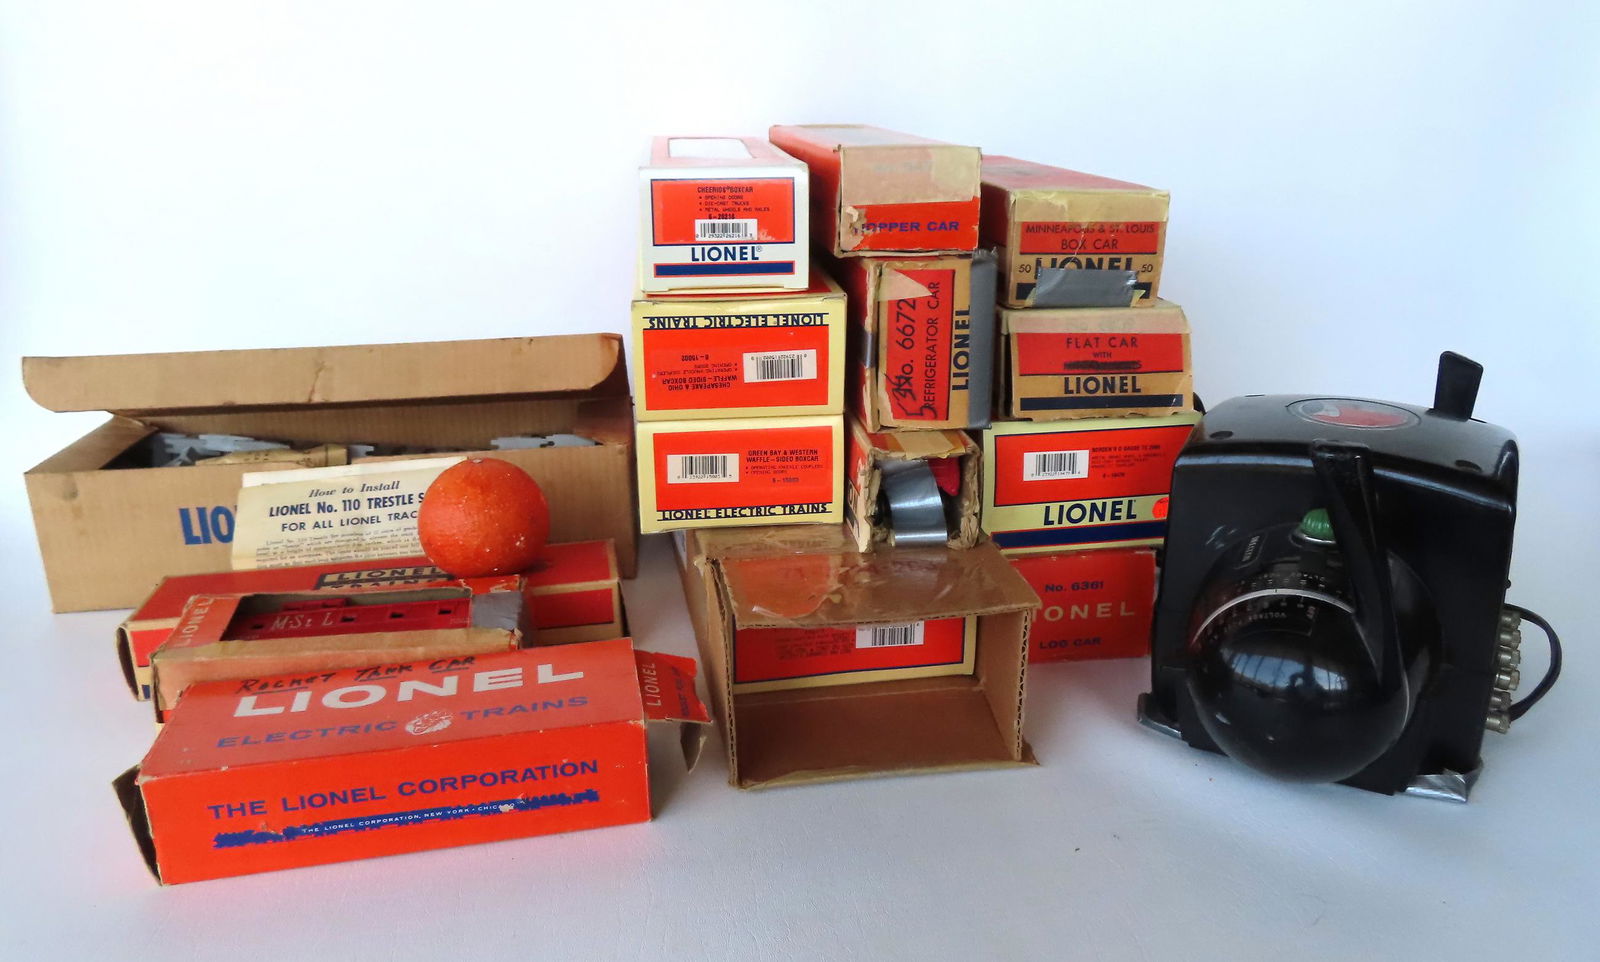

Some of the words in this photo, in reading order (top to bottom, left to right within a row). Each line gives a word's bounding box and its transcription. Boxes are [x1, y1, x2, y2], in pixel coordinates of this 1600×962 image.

[927, 221, 959, 231] CAR
[1125, 224, 1155, 233] LOUIS
[1061, 239, 1086, 250] BOX
[1093, 239, 1118, 250] CAR
[1018, 264, 1031, 273] 50
[1141, 264, 1153, 273] 50
[927, 282, 940, 310] CAR
[649, 317, 698, 329] TRAINS
[704, 315, 768, 327] ELECTRIC
[774, 314, 824, 326] LIONEL
[896, 299, 916, 350] 6672
[952, 305, 970, 391] LIONEL
[1066, 338, 1100, 348] FLAT
[1108, 336, 1139, 348] CAR
[924, 317, 939, 408] REFRIGERATOR
[692, 382, 730, 390] CHESAPEAKE
[1064, 376, 1141, 394] LIONEL
[309, 489, 336, 498] How
[360, 480, 400, 493] Install
[269, 503, 311, 518] LIONEL
[317, 502, 338, 514] No.
[342, 499, 360, 512] 110
[367, 494, 414, 509] TRESTLE
[662, 510, 711, 521] LIONEL
[715, 506, 777, 518] ELECTRIC
[782, 503, 828, 515] TRAINS
[1043, 499, 1137, 526] LIONEL
[179, 506, 235, 545] LIO
[281, 522, 306, 532] FOR
[312, 521, 333, 530] ALL
[340, 516, 382, 527] LIONEL
[388, 510, 418, 521] TRAC
[338, 567, 445, 580] LIONEL
[1044, 584, 1066, 592] No.
[1071, 581, 1104, 591] 6361
[1031, 601, 1135, 622] IONEL
[1040, 640, 1068, 649] LOG
[1073, 637, 1102, 648] CAR
[236, 673, 337, 694] ROCKET
[428, 656, 476, 670] CAR
[233, 664, 584, 717] LIONEL
[642, 663, 661, 706] LIONEL
[216, 720, 398, 748] ELECTRIC
[460, 696, 590, 720] TRAINS
[208, 801, 267, 819] THE
[281, 786, 387, 812] LIONEL
[398, 760, 598, 796] CORPORATION
[324, 823, 355, 831] LIONEL
[359, 814, 421, 826] CORPORATION,
